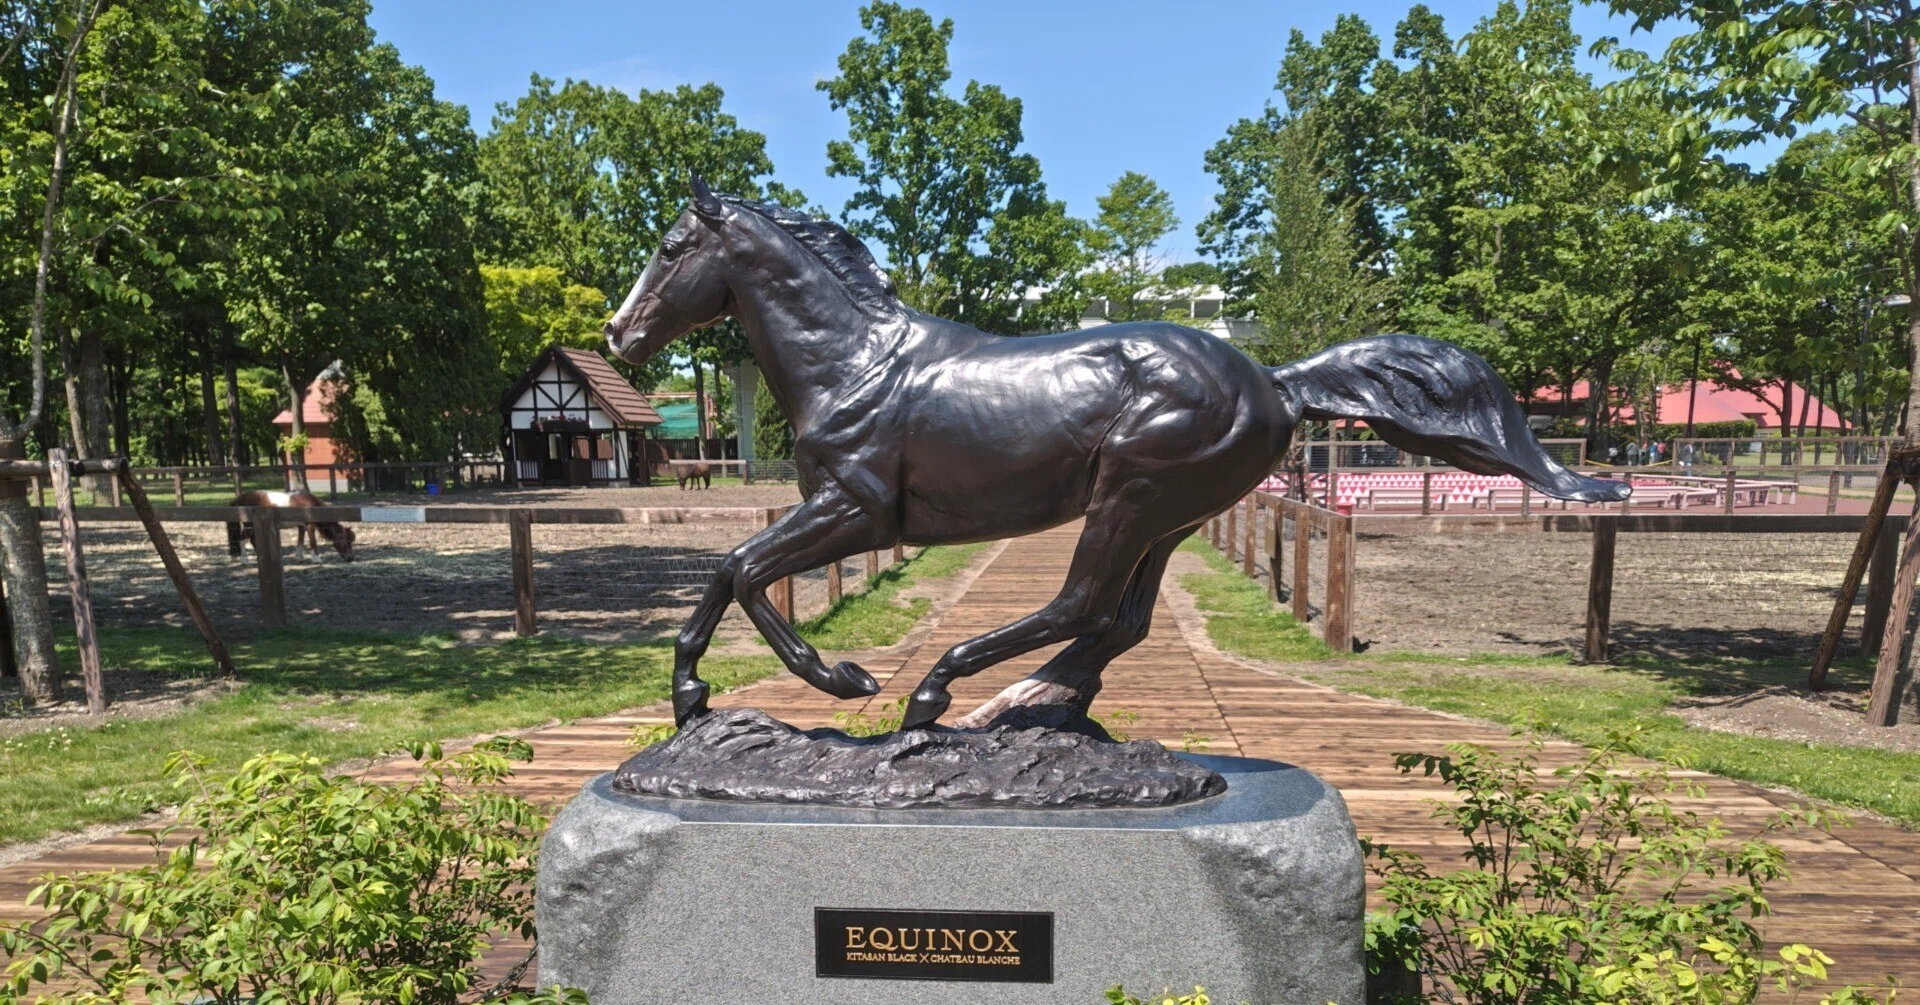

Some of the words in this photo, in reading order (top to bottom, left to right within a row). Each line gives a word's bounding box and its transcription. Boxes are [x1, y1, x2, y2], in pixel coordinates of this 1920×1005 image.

[846, 926, 1019, 952] EQUINOX
[846, 952, 886, 962] KITASAN
[887, 953, 918, 963] BLACK
[931, 954, 975, 964] CHATEAU
[977, 955, 1021, 965] BLANCHE
